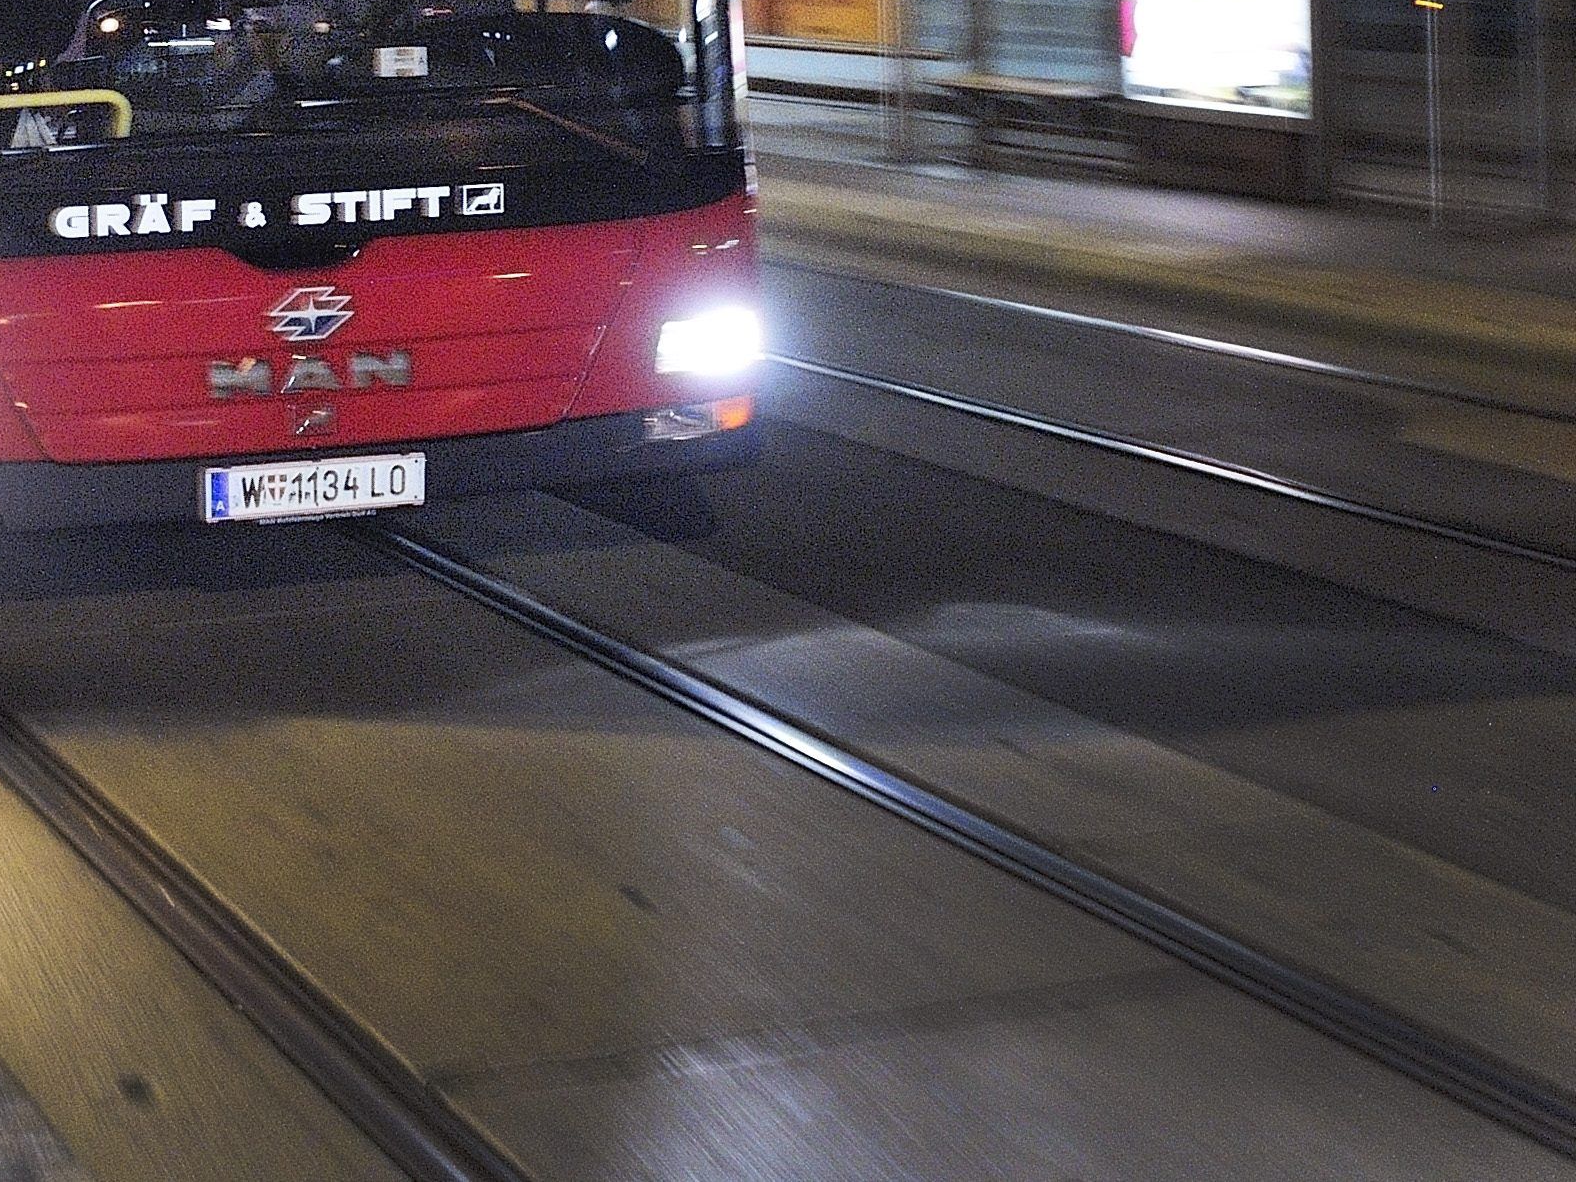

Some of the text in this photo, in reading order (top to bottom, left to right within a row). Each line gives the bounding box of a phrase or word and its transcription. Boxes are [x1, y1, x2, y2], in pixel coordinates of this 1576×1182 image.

[52, 185, 451, 239] GRÄF & STIFT
[209, 352, 413, 399] MAN
[215, 500, 225, 512] A
[241, 474, 266, 508] W
[290, 469, 359, 506] 1134
